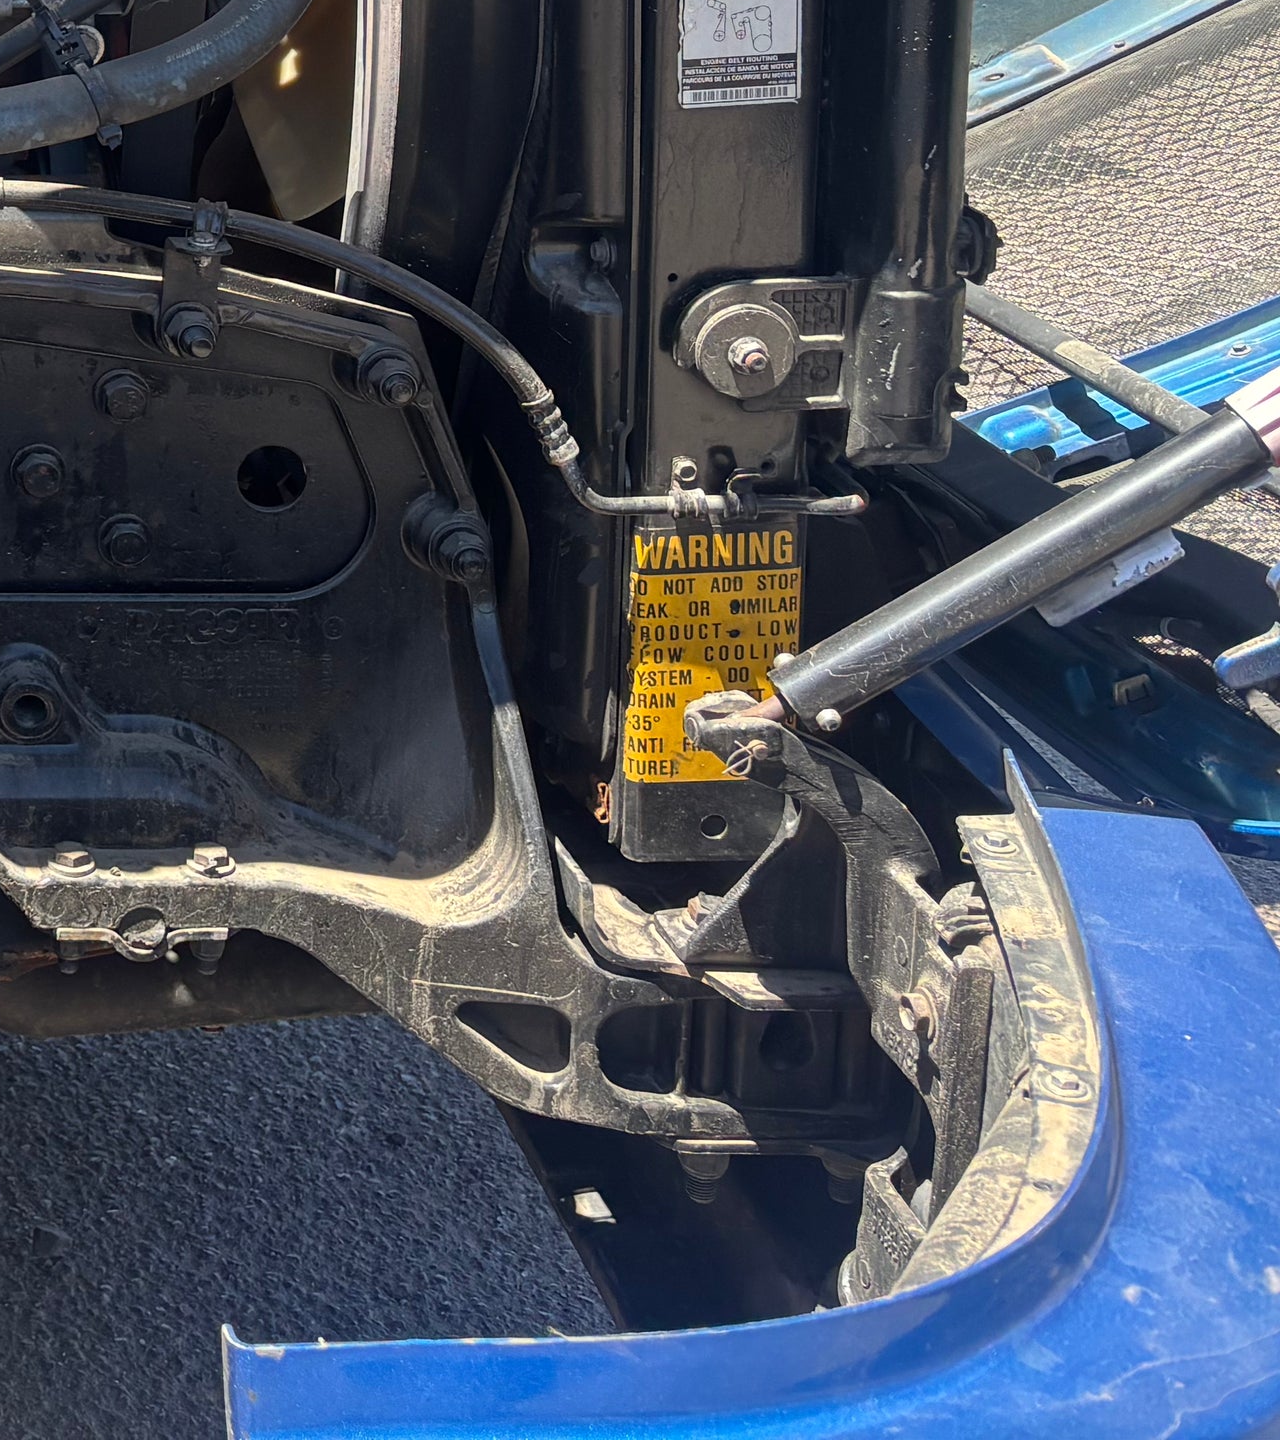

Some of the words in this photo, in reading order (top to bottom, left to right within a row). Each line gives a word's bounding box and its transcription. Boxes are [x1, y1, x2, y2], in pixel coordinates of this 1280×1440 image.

[700, 58, 727, 66] ENGINE
[746, 55, 779, 63] ROUTING
[634, 529, 794, 571] WARNING
[663, 577, 696, 595] NOT
[710, 576, 744, 593] ADD
[757, 572, 799, 591] STOP
[688, 600, 710, 617] OR
[757, 618, 798, 637] LOW
[704, 641, 798, 663] COOLING
[727, 666, 750, 684] DO
[629, 692, 676, 709] DRAIN
[627, 737, 664, 754] ANTI
